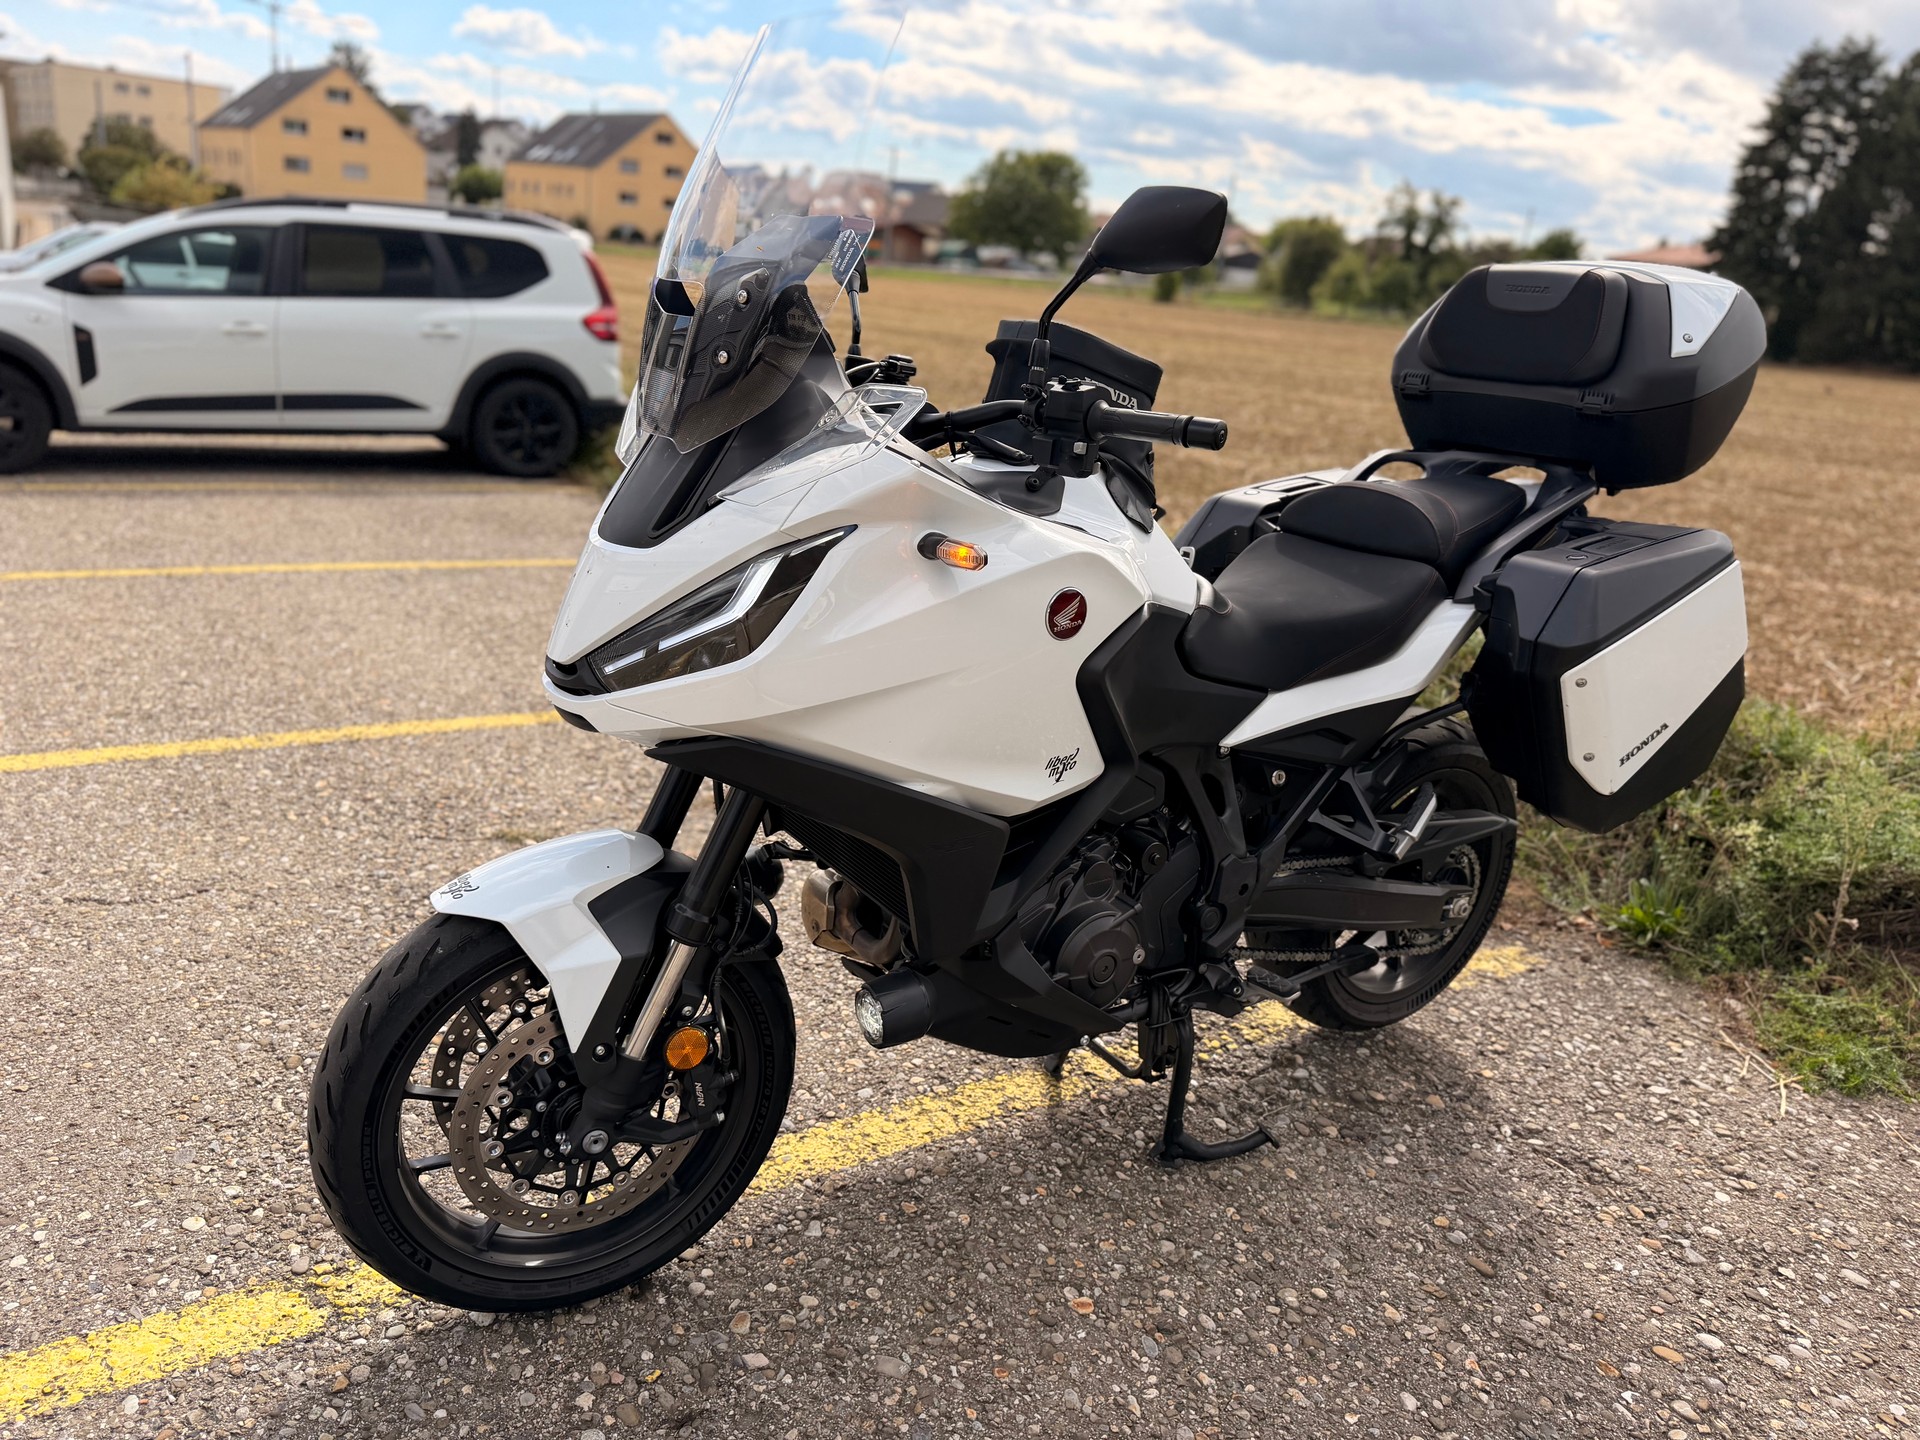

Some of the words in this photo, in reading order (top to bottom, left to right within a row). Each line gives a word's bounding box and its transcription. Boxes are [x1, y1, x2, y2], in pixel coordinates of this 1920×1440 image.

[1053, 620, 1082, 633] HONDA
[1619, 723, 1670, 767] HONDA
[740, 982, 772, 1046] MICHELIN
[694, 1082, 705, 1107] NISSIN
[362, 1127, 375, 1179] POWER
[367, 1187, 414, 1257] MICHELIN
